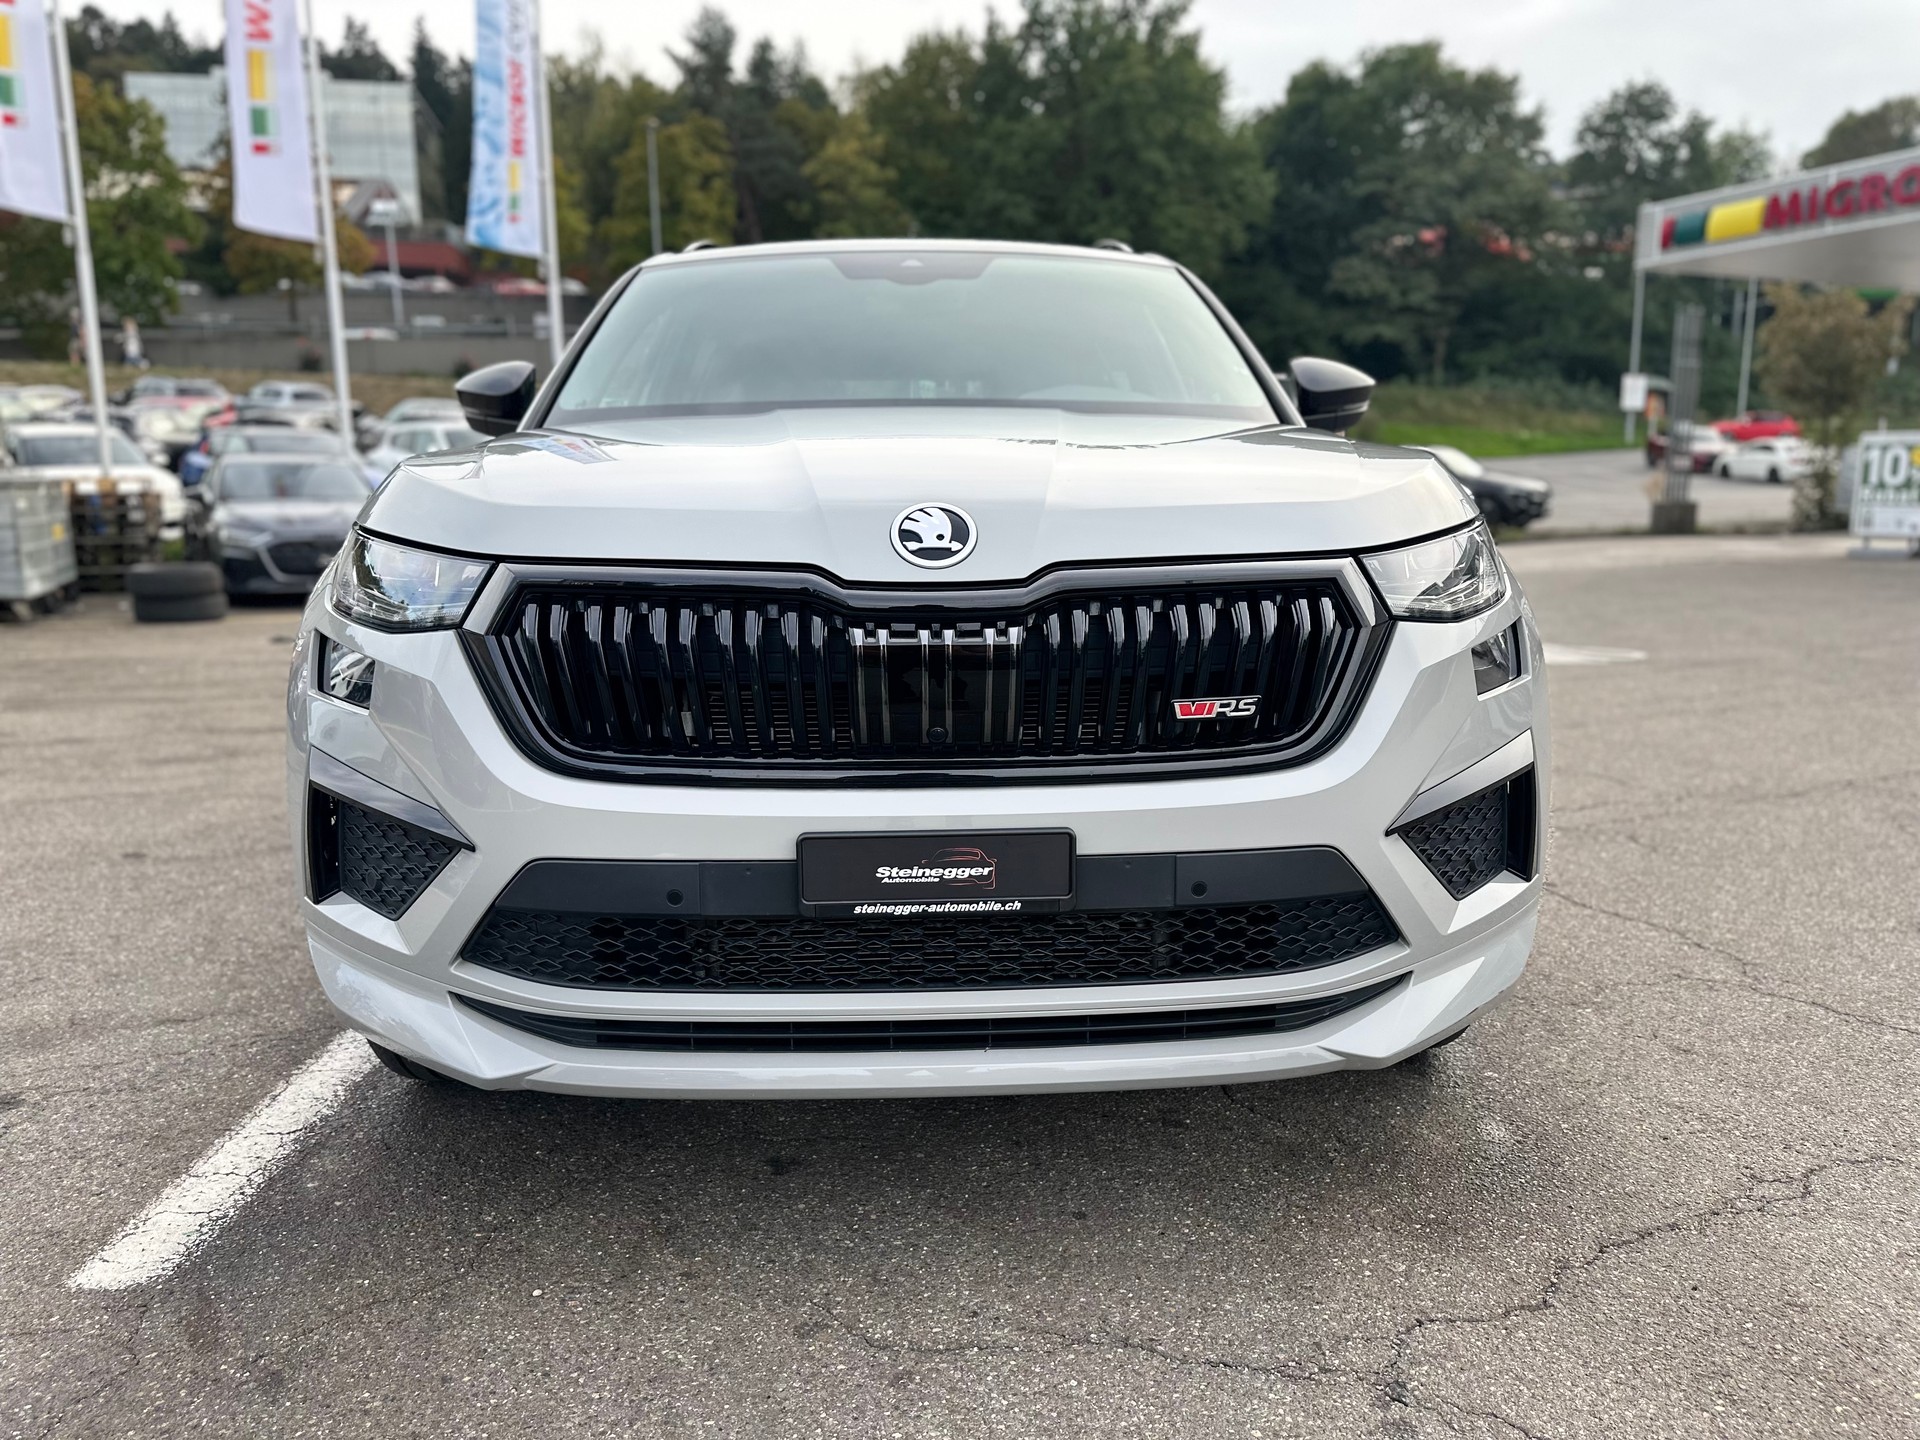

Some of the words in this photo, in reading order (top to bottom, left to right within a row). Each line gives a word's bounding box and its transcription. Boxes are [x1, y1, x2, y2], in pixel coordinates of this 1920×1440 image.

[875, 865, 994, 879] Steinegger
[881, 876, 940, 884] Automobile
[853, 900, 1022, 915] steinegger-automobile.ch
